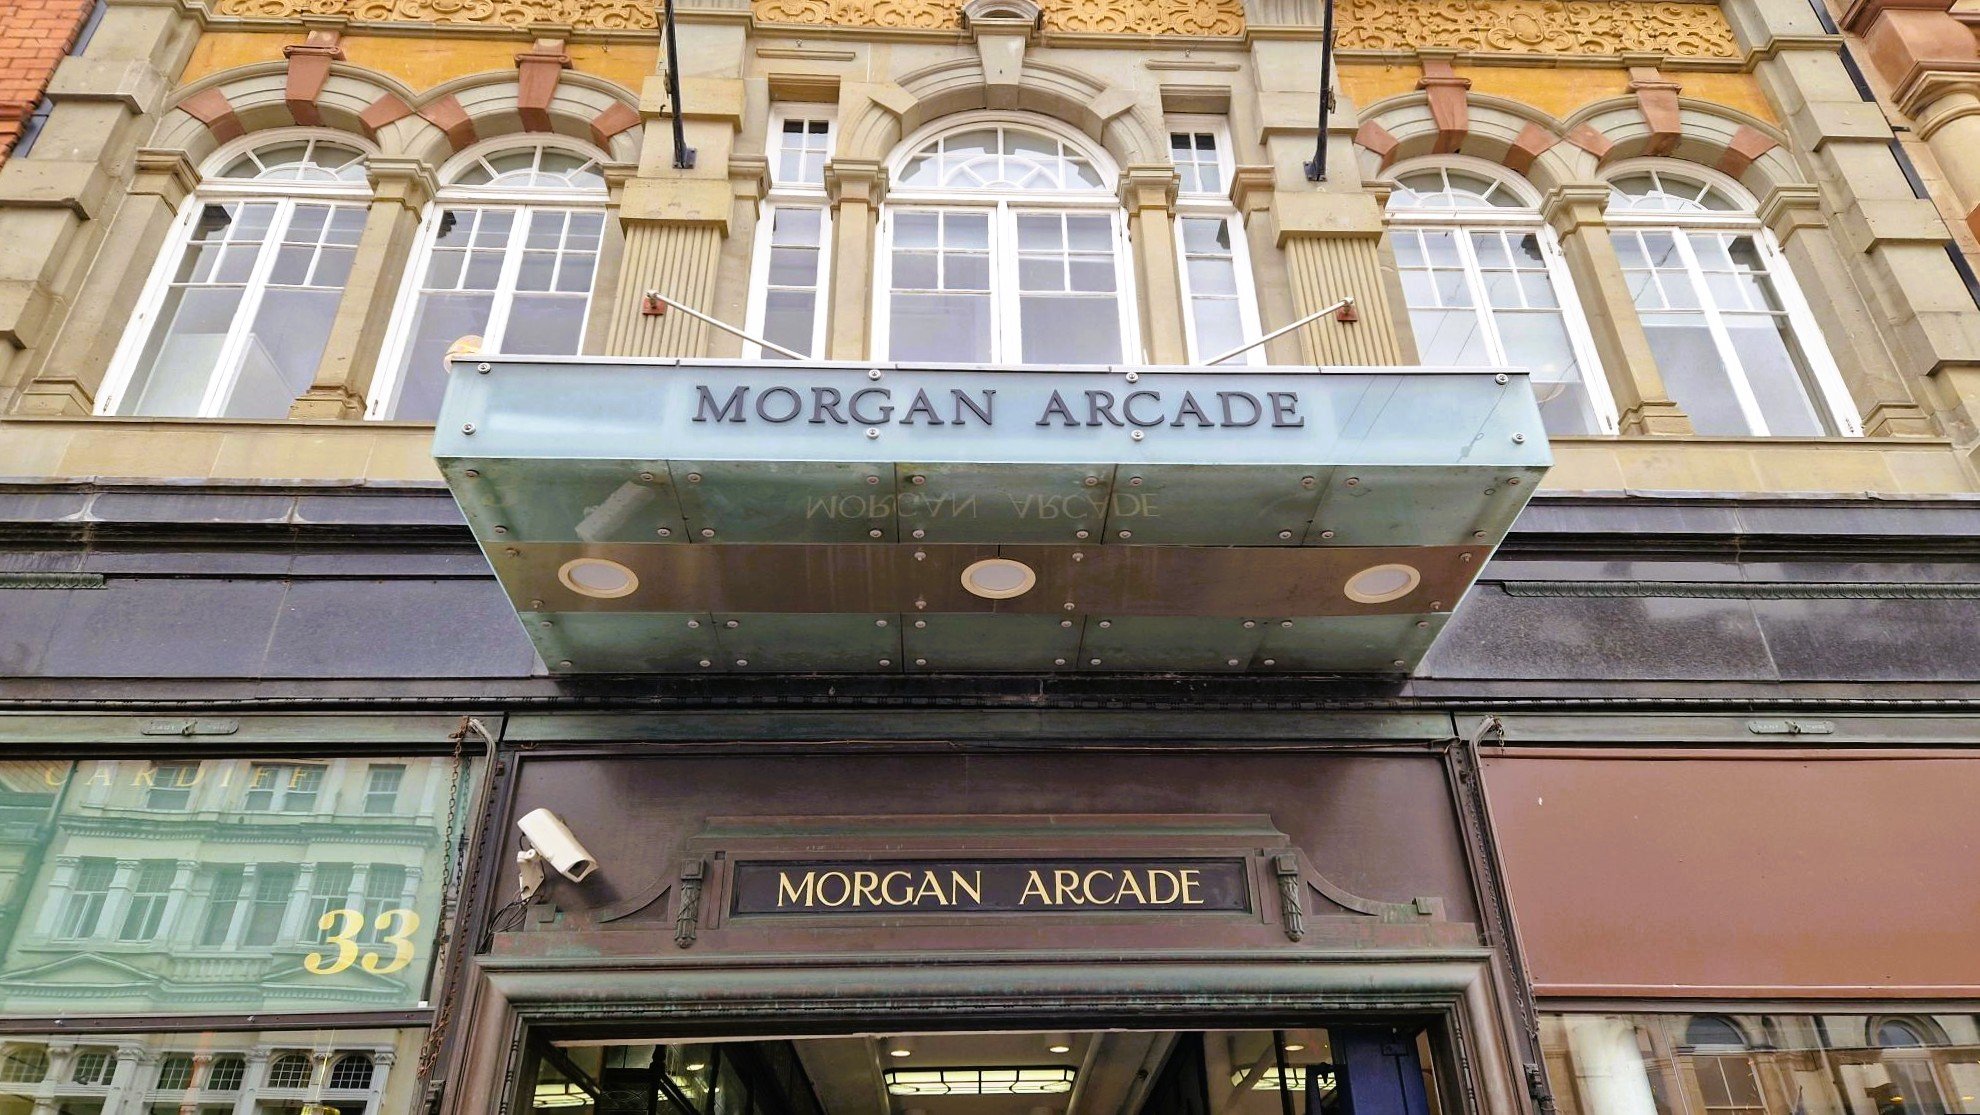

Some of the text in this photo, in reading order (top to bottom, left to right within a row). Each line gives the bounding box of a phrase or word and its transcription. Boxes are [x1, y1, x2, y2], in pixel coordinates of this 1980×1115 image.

[692, 385, 1306, 429] MORGAN ARCADE
[44, 765, 312, 788] CARDIFF
[777, 868, 1205, 908] MORGAN ARCADE
[303, 908, 421, 976] 33
